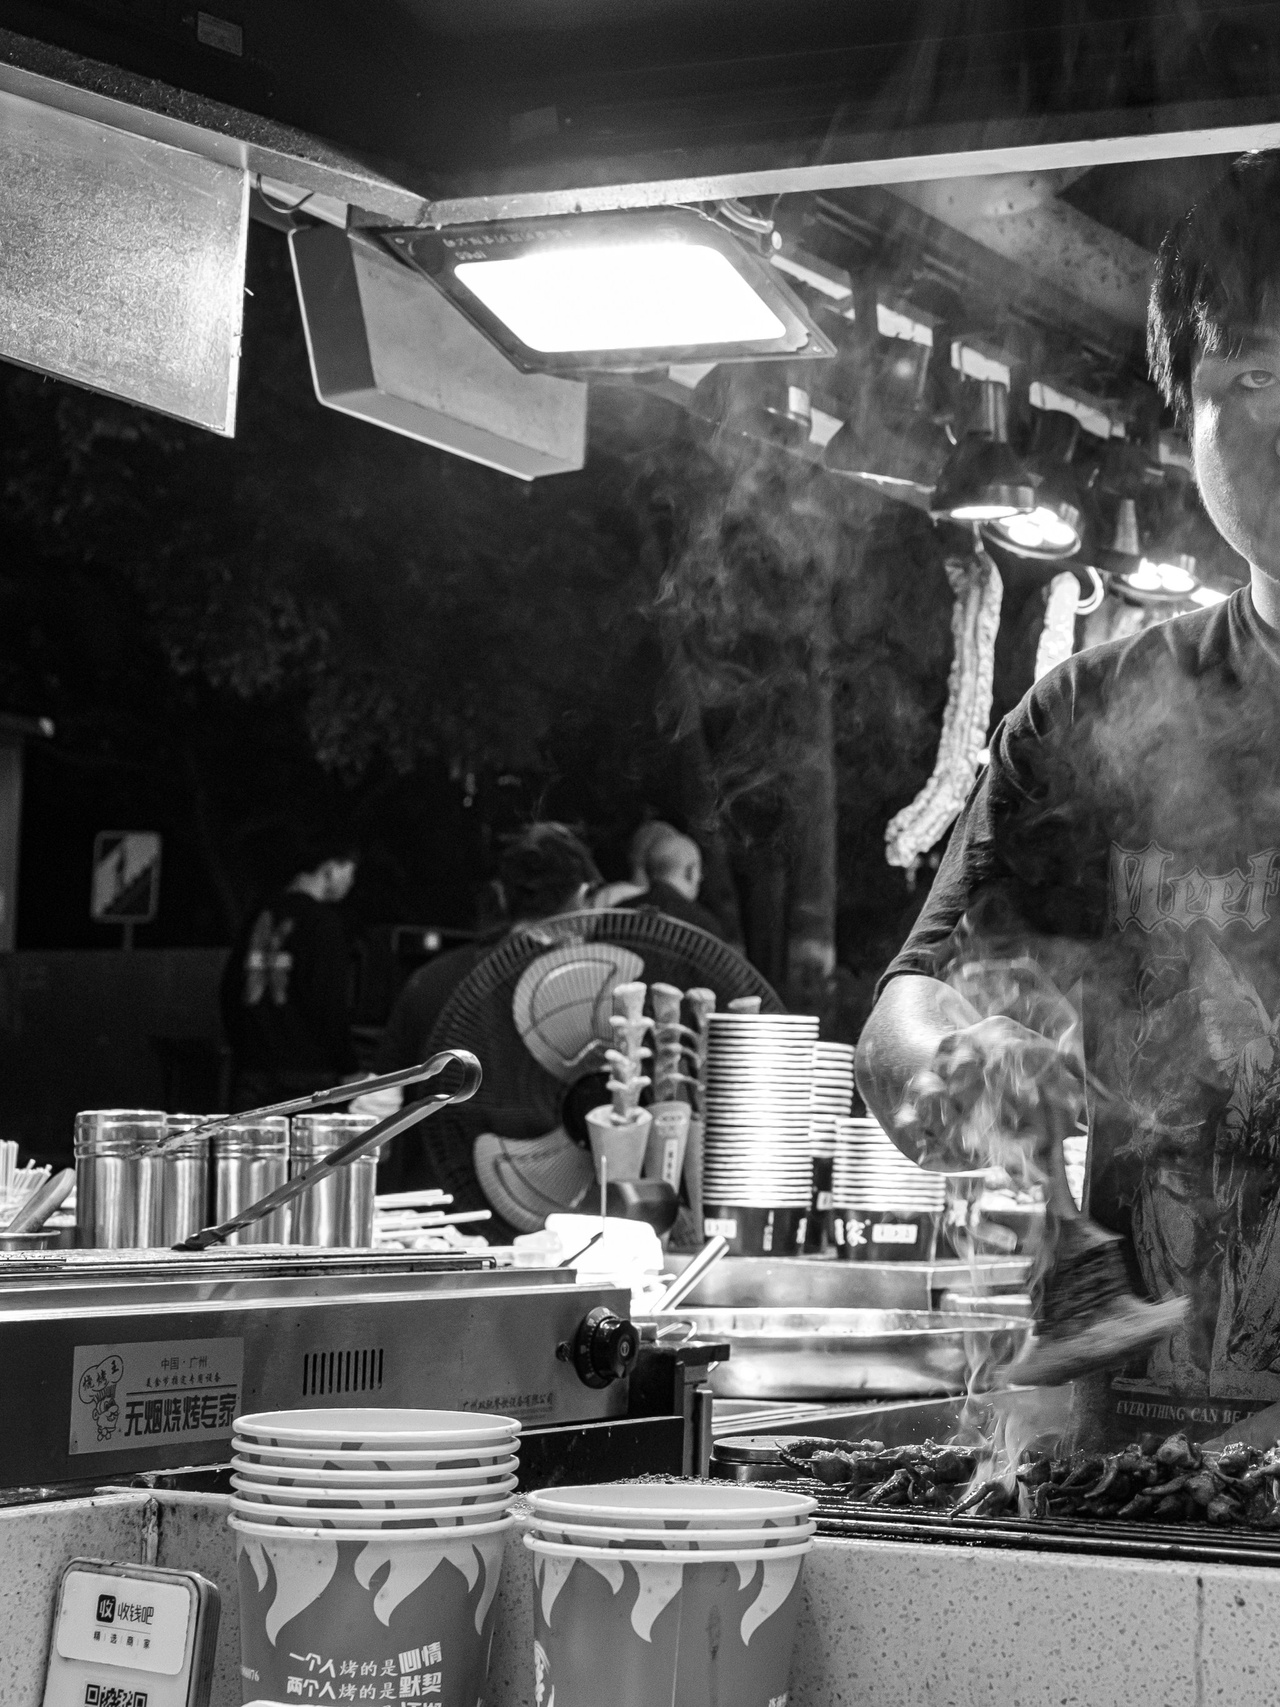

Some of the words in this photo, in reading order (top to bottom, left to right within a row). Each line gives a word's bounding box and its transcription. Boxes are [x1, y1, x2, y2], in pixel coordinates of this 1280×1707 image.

[124, 1392, 237, 1438] 无烟烧烤专家
[1116, 1401, 1186, 1421] EVERYTHING
[1190, 1407, 1219, 1423] CAN
[117, 1602, 155, 1626] 收钱吧
